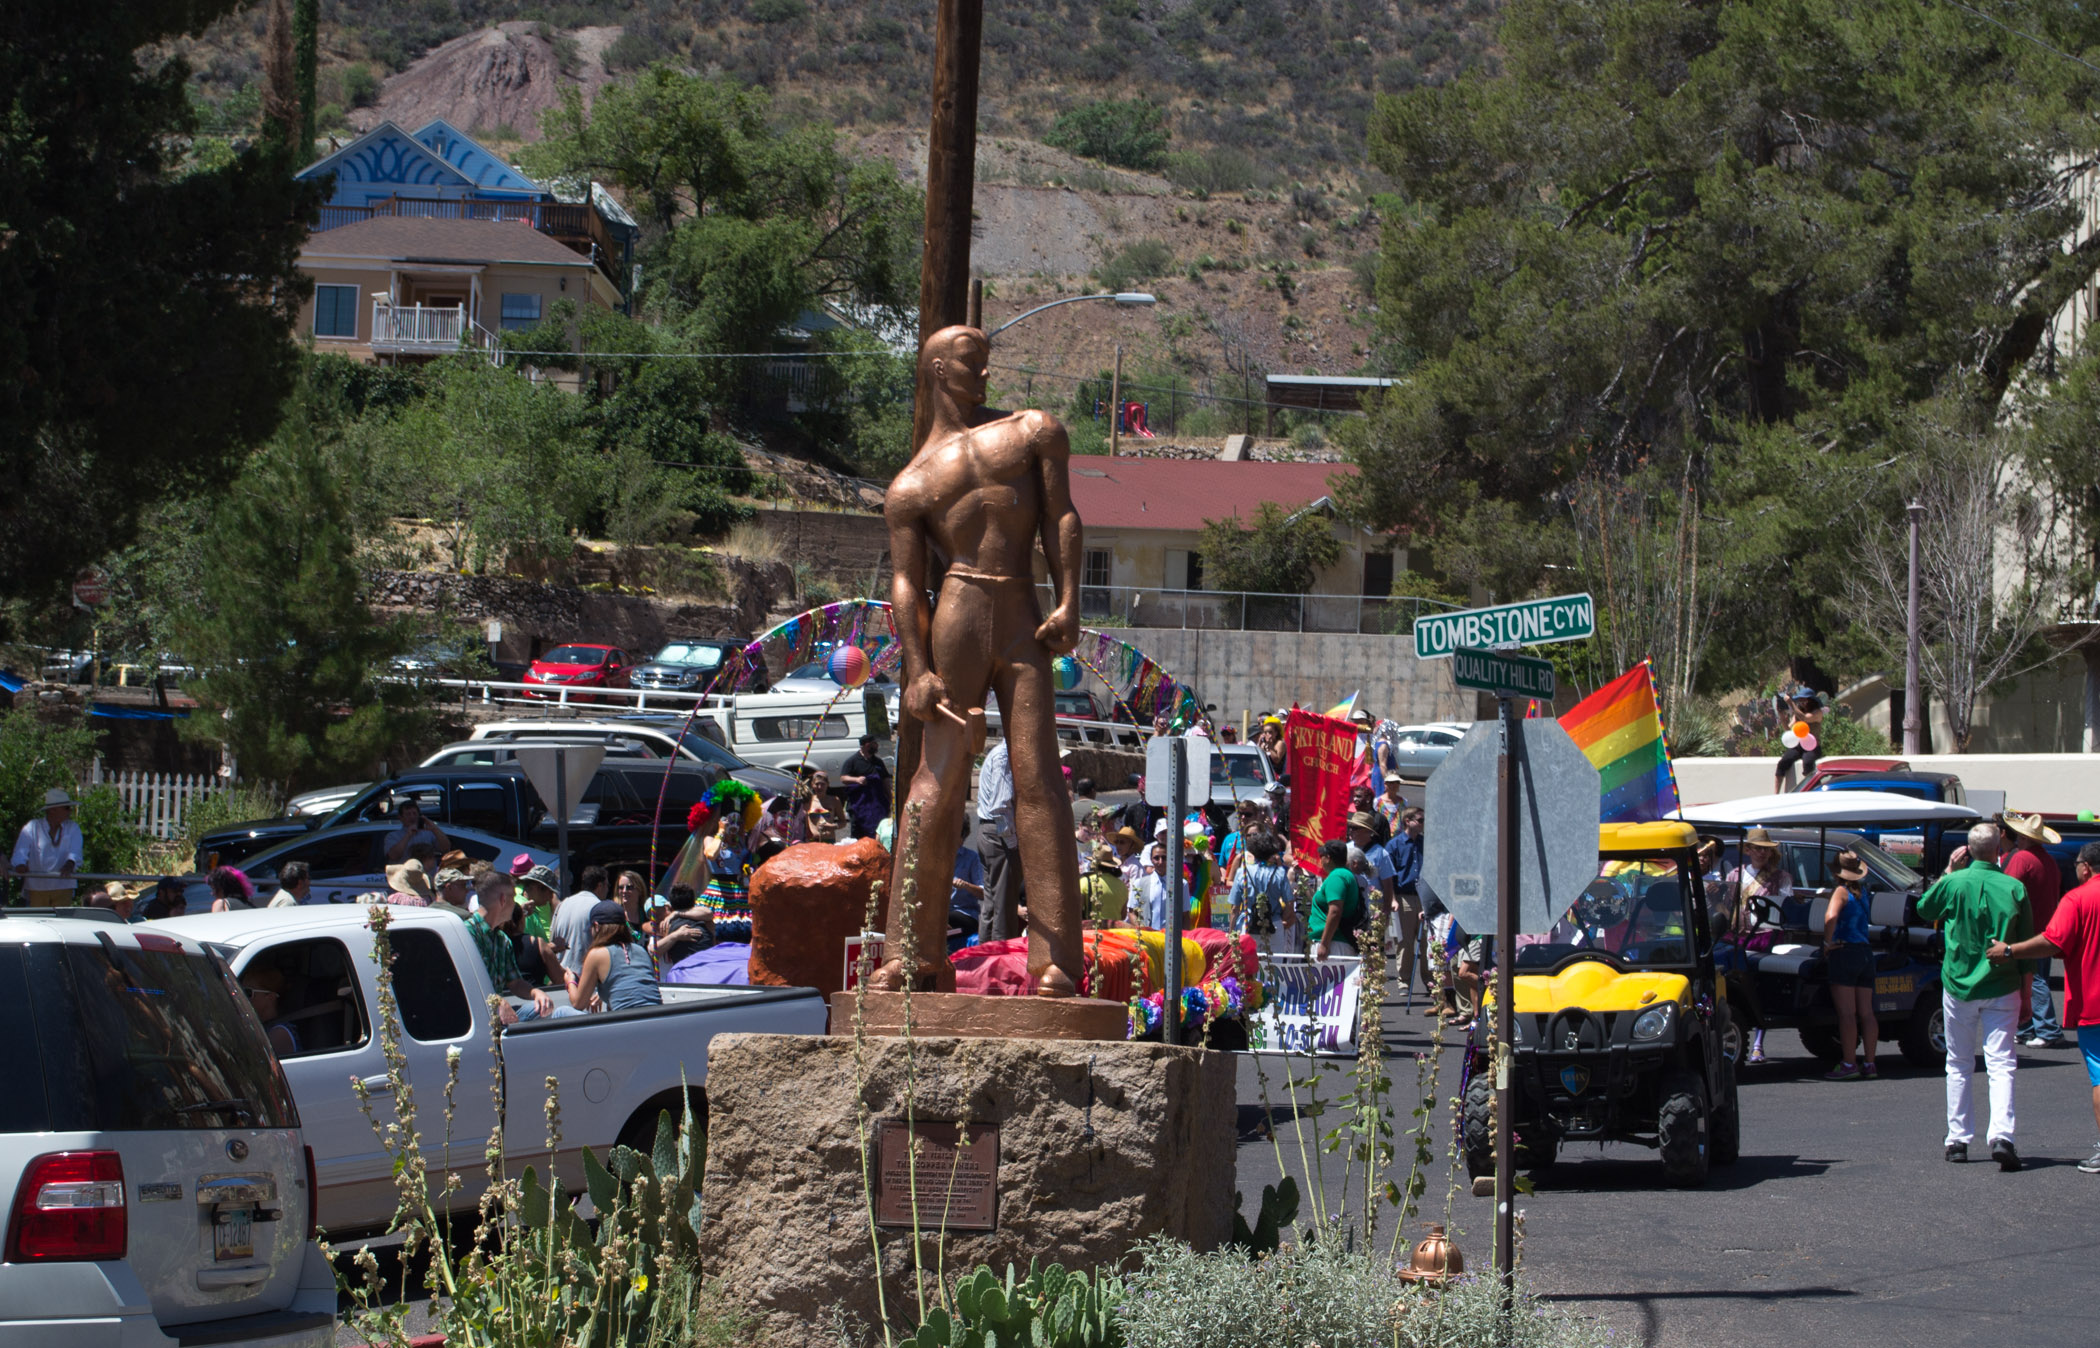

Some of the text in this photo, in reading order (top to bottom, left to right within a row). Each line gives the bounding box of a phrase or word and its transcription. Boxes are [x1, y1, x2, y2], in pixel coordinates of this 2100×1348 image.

[1418, 603, 1590, 652] TOMBSTONE CYN
[1456, 655, 1554, 692] QUALITY HILL RD
[1294, 726, 1353, 762] SKY ISLAND
[1303, 755, 1339, 775] CHURCH
[1274, 964, 1345, 1017] CHURCH
[1317, 1025, 1340, 1051] AM
[949, 1162, 979, 1170] MNERS
